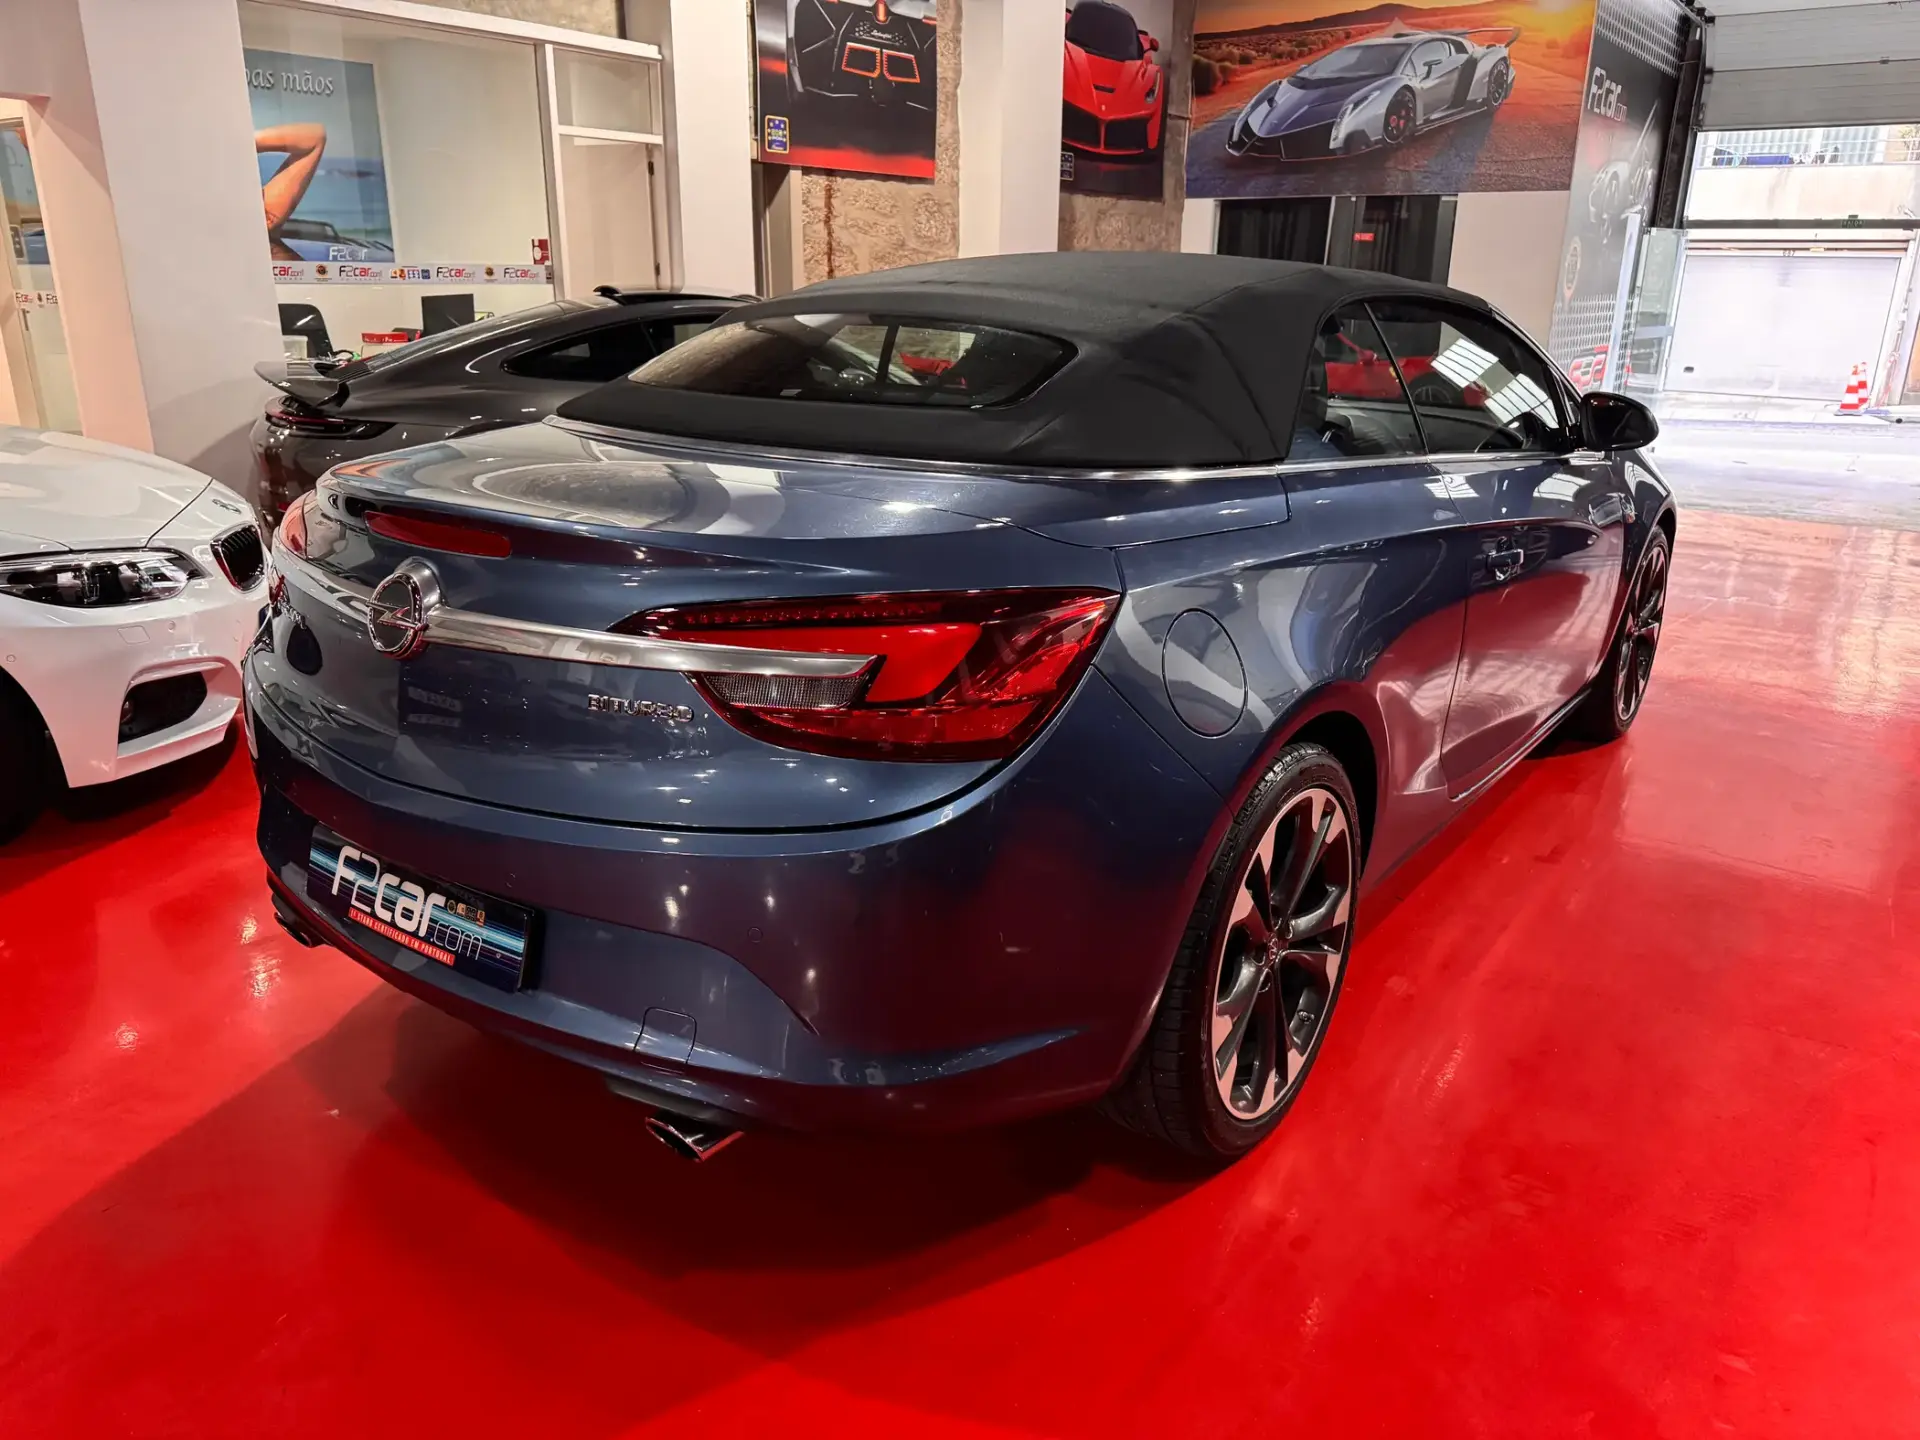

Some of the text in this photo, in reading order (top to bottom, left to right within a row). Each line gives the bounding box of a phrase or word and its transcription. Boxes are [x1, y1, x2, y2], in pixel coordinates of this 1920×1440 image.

[281, 70, 334, 95] mãos
[587, 693, 694, 722] BITURBO
[374, 921, 409, 946] CERTIFICADO
[411, 938, 419, 949] EM
[421, 942, 452, 964] PORTUGAL
